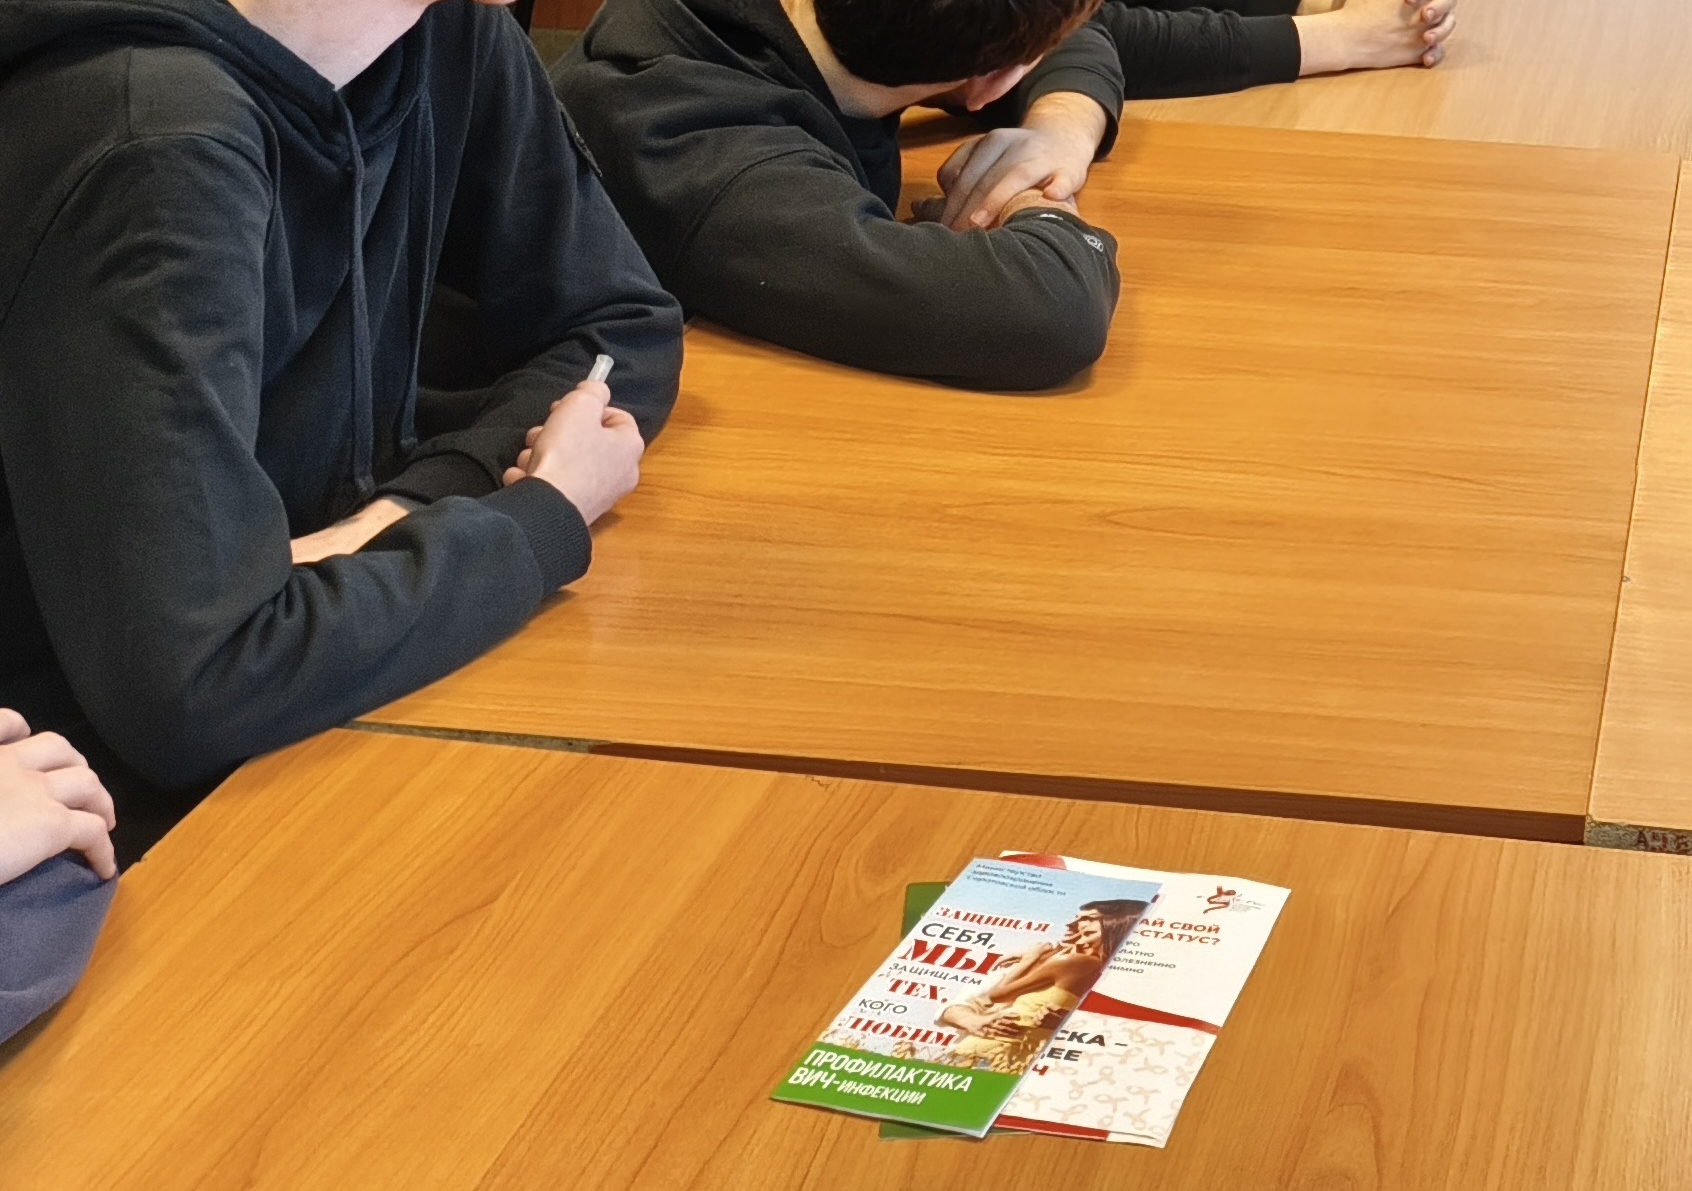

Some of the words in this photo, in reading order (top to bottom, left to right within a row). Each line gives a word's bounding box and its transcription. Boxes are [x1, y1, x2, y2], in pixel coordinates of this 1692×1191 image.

[936, 907, 1052, 933] ЗАЩИЩАЯ
[1139, 917, 1166, 928] АЙ
[1169, 921, 1221, 935] СВОЙ
[921, 923, 997, 949] СЕБЯ,
[1133, 928, 1221, 946] -СТАТУС?
[898, 939, 1004, 975] МЫ
[1118, 948, 1155, 958] ЛАТНО
[1112, 956, 1177, 969] ОЛЕЗНЕННО
[888, 962, 983, 986] ЗАЩИЩАЕМ
[887, 978, 948, 1003] ТЕХ,
[858, 998, 908, 1014] КОГО
[838, 1015, 958, 1047] ЛЮБИМ
[1054, 1029, 1106, 1047] СКА
[1040, 1047, 1082, 1062] ЕЕ
[803, 1048, 973, 1092] ПРОФИЛАКТИКА
[1031, 1063, 1049, 1076] Ч
